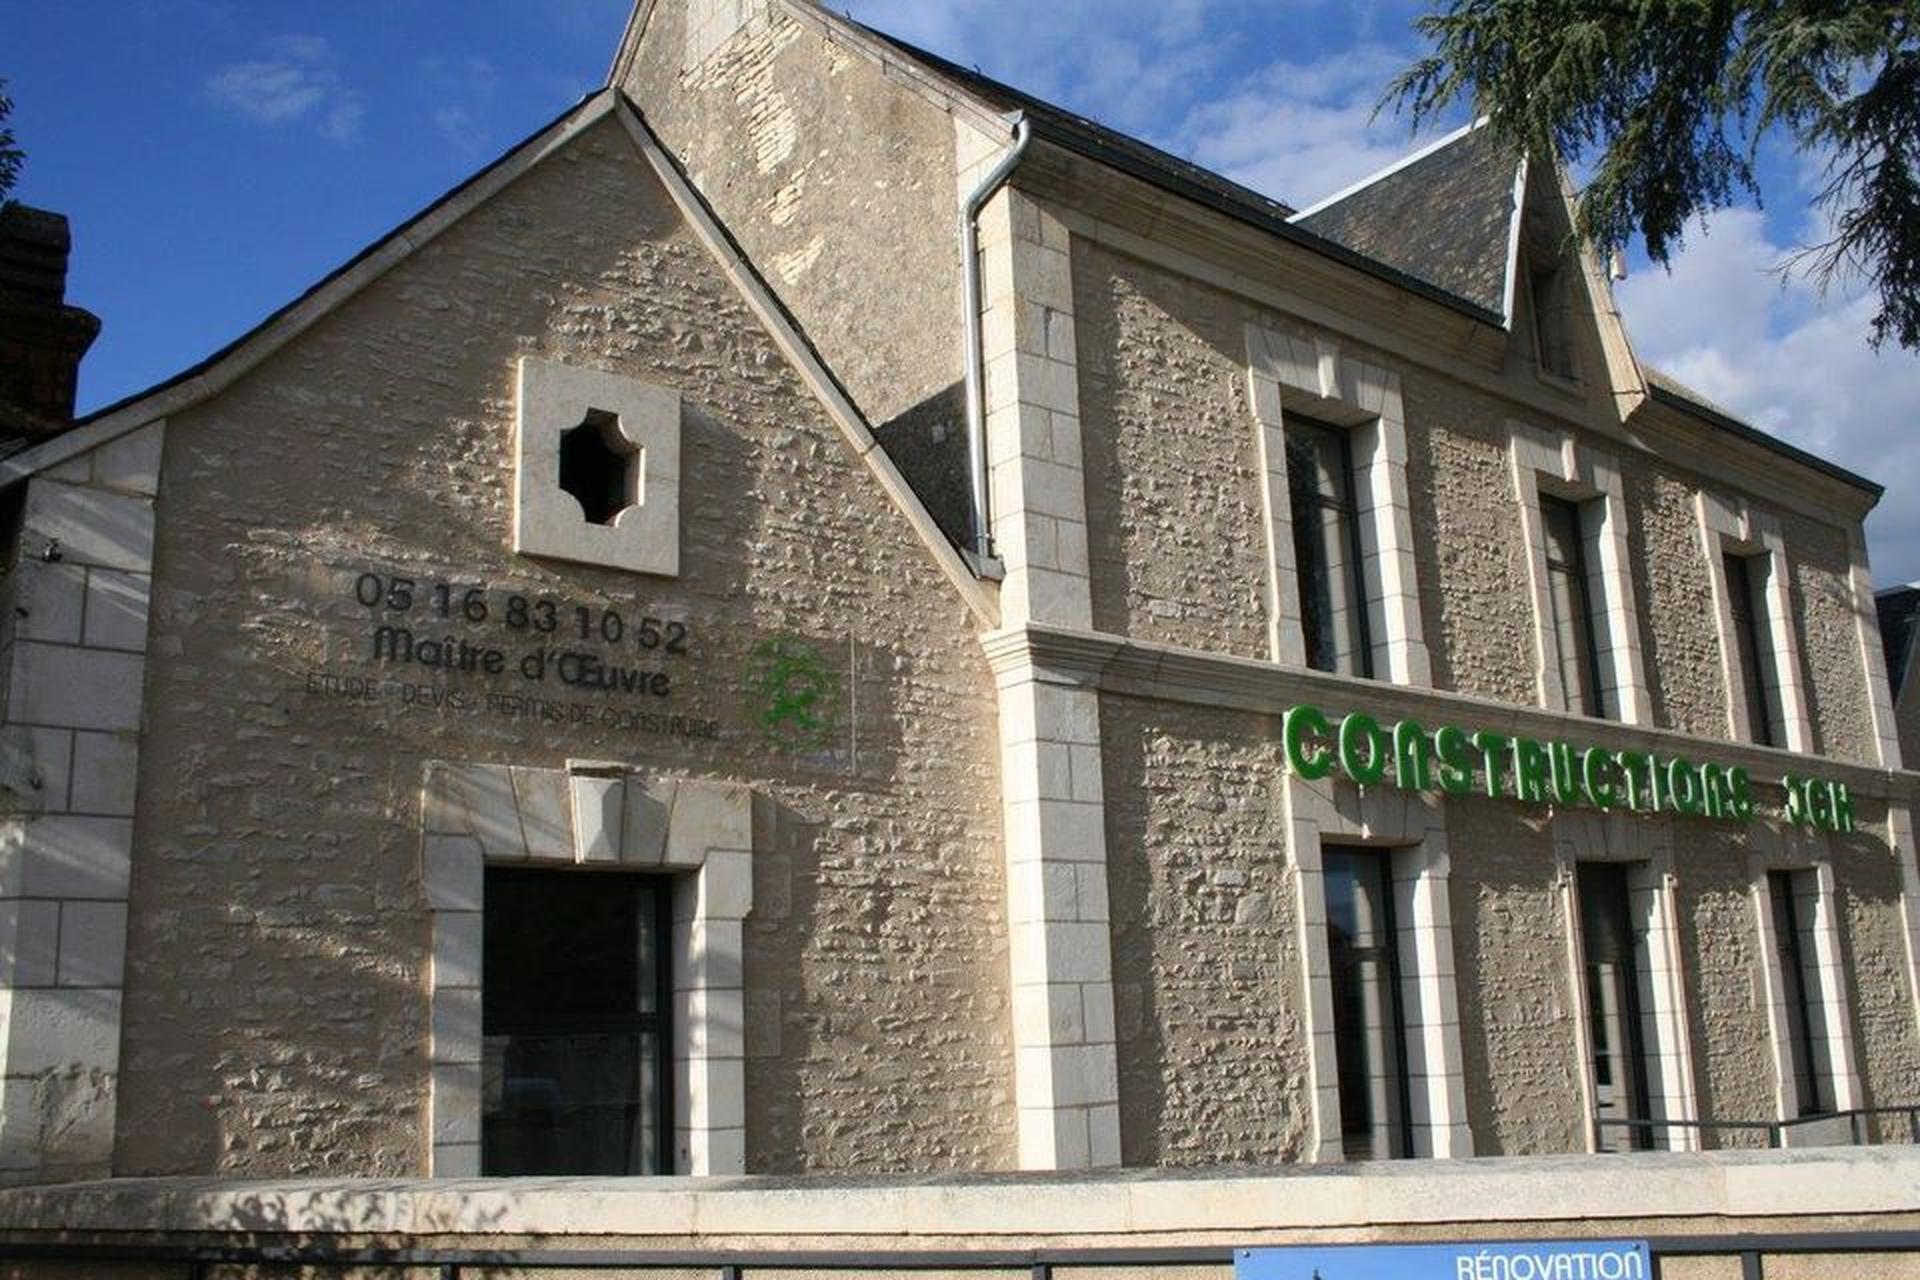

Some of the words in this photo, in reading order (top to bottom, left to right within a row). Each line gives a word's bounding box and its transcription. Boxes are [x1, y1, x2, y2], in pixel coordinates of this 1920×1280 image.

[356, 573, 415, 611] 05
[434, 583, 488, 622] 16
[505, 595, 557, 632] 83
[575, 606, 623, 643] 10
[639, 617, 688, 654] 52
[373, 625, 504, 674] Maître
[1282, 703, 1753, 821] CONSTRUCTIONS
[1456, 1250, 1643, 1280] RÉNOVATION
